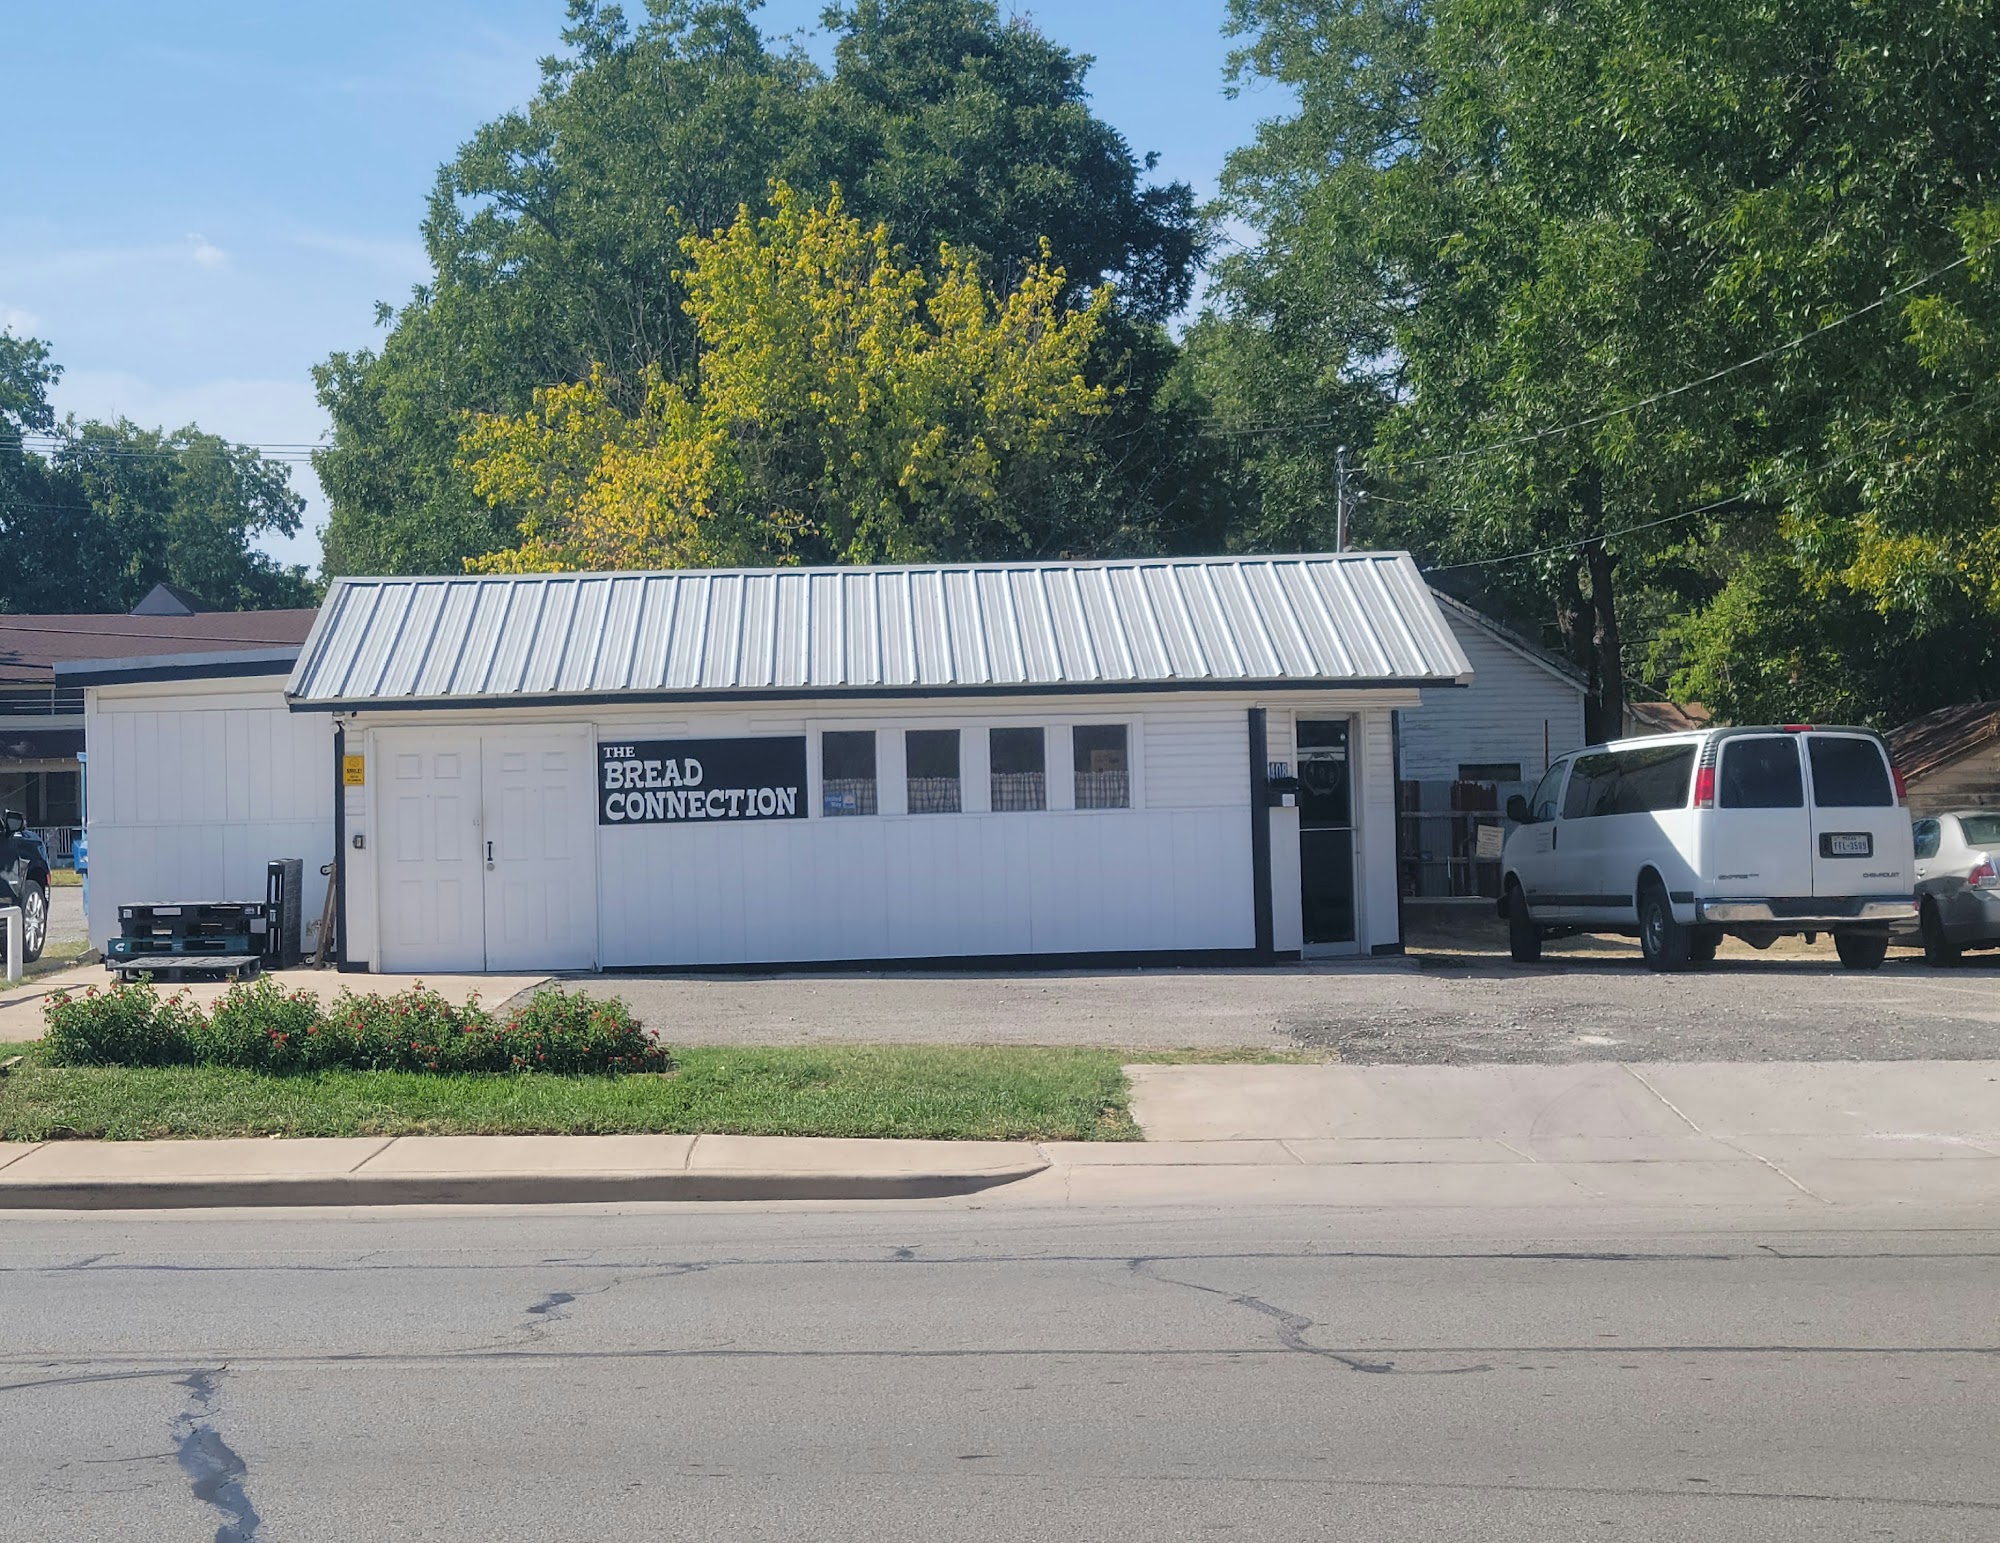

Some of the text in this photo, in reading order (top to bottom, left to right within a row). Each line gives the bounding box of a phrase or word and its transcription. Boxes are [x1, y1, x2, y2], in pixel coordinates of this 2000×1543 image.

[604, 746, 635, 758] THE
[604, 758, 703, 789] BREAD
[605, 787, 797, 821] CONNECTION
